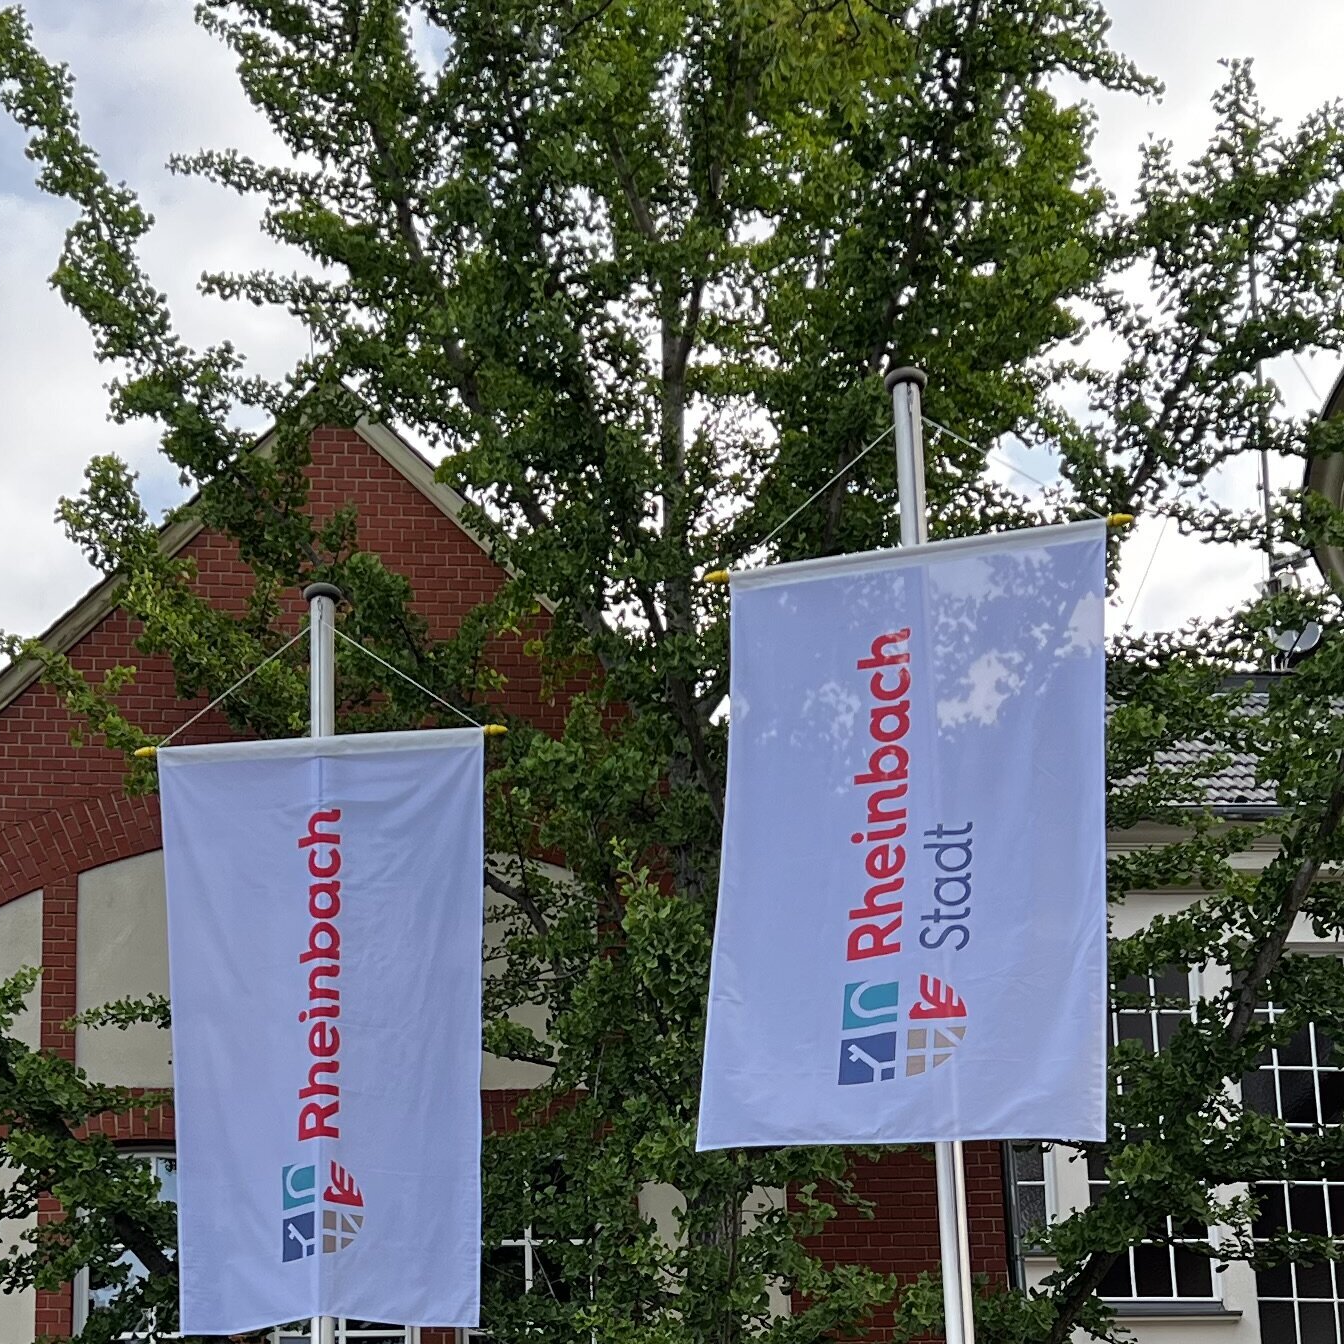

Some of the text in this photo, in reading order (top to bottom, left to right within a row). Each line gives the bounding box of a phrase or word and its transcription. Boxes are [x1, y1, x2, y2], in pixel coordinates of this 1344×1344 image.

[847, 628, 912, 962] Rheinbach
[920, 822, 973, 951] Stadt
[298, 808, 342, 1142] Rheinbach
